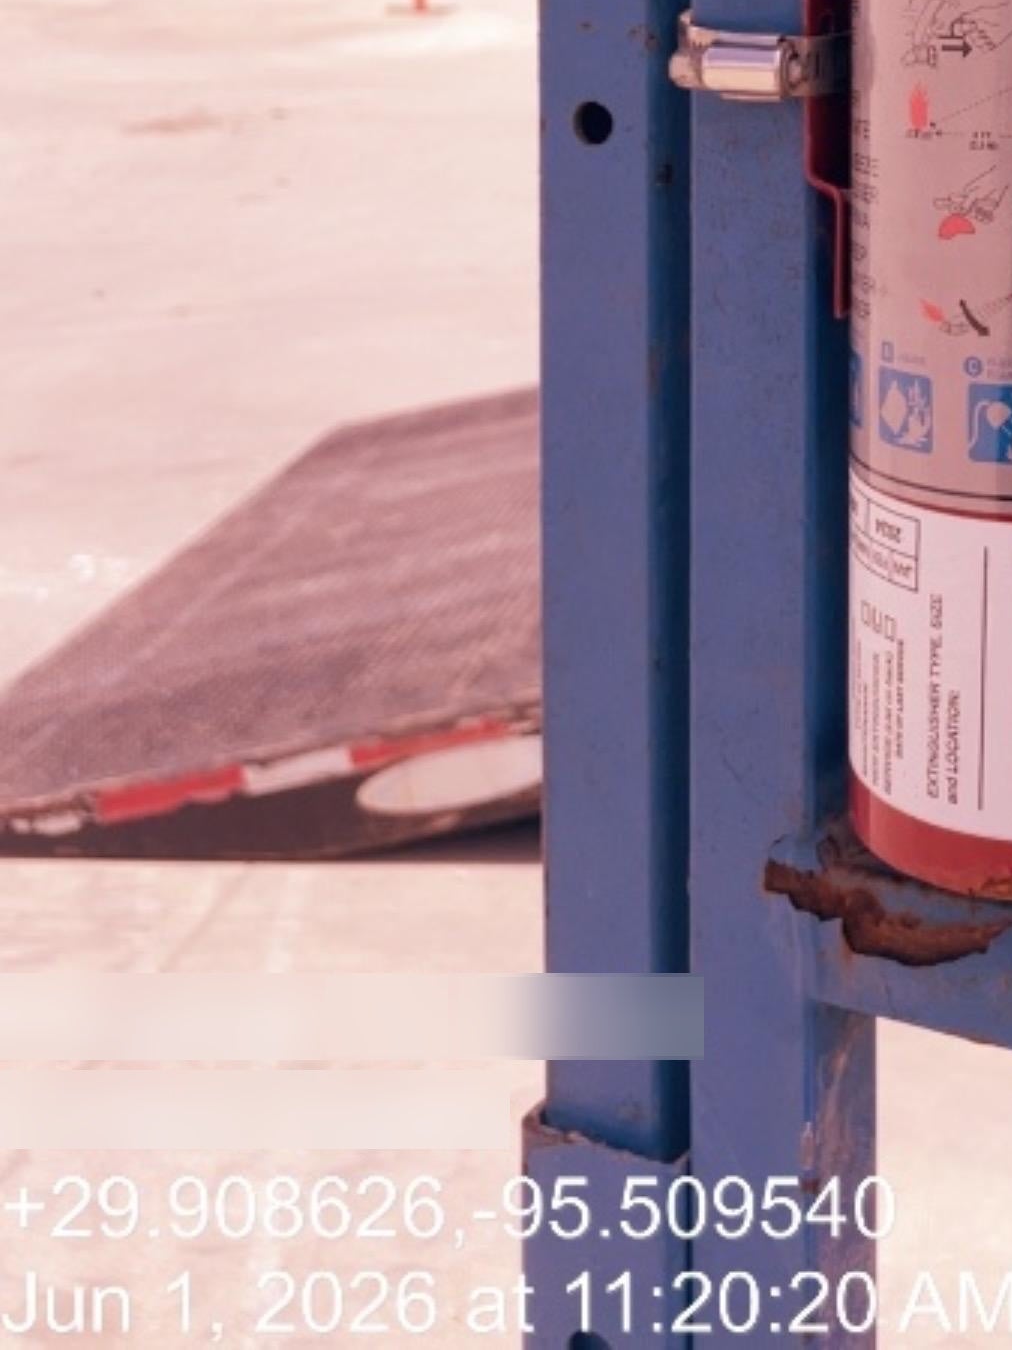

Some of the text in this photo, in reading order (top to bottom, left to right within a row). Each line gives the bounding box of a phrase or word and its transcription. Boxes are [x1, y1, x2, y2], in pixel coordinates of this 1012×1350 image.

[929, 593, 943, 631] SIZE
[926, 682, 941, 799] EXTINGUISHER
[947, 776, 959, 805] and
